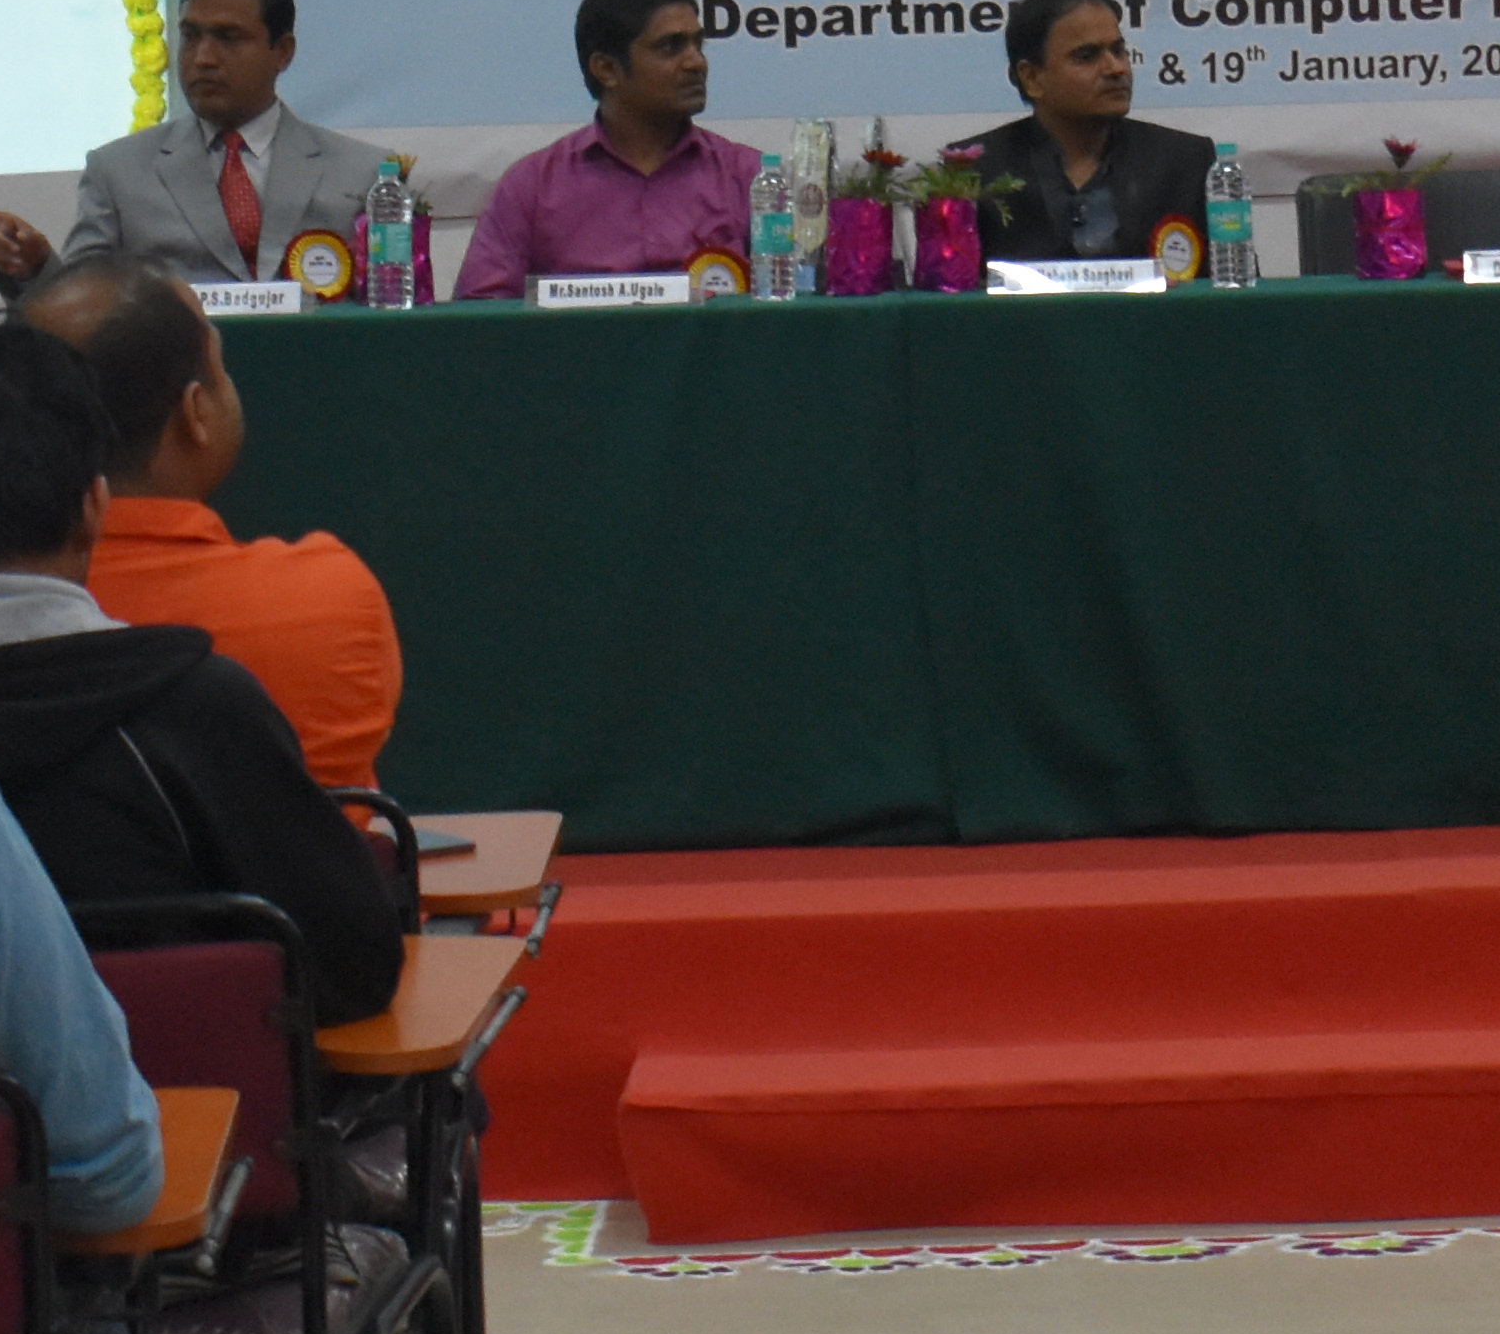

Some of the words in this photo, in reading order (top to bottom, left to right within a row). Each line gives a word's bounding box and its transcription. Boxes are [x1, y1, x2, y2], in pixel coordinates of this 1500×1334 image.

[1158, 53, 1187, 85] &
[1200, 44, 1266, 84] 19th
[1278, 44, 1448, 84] January,
